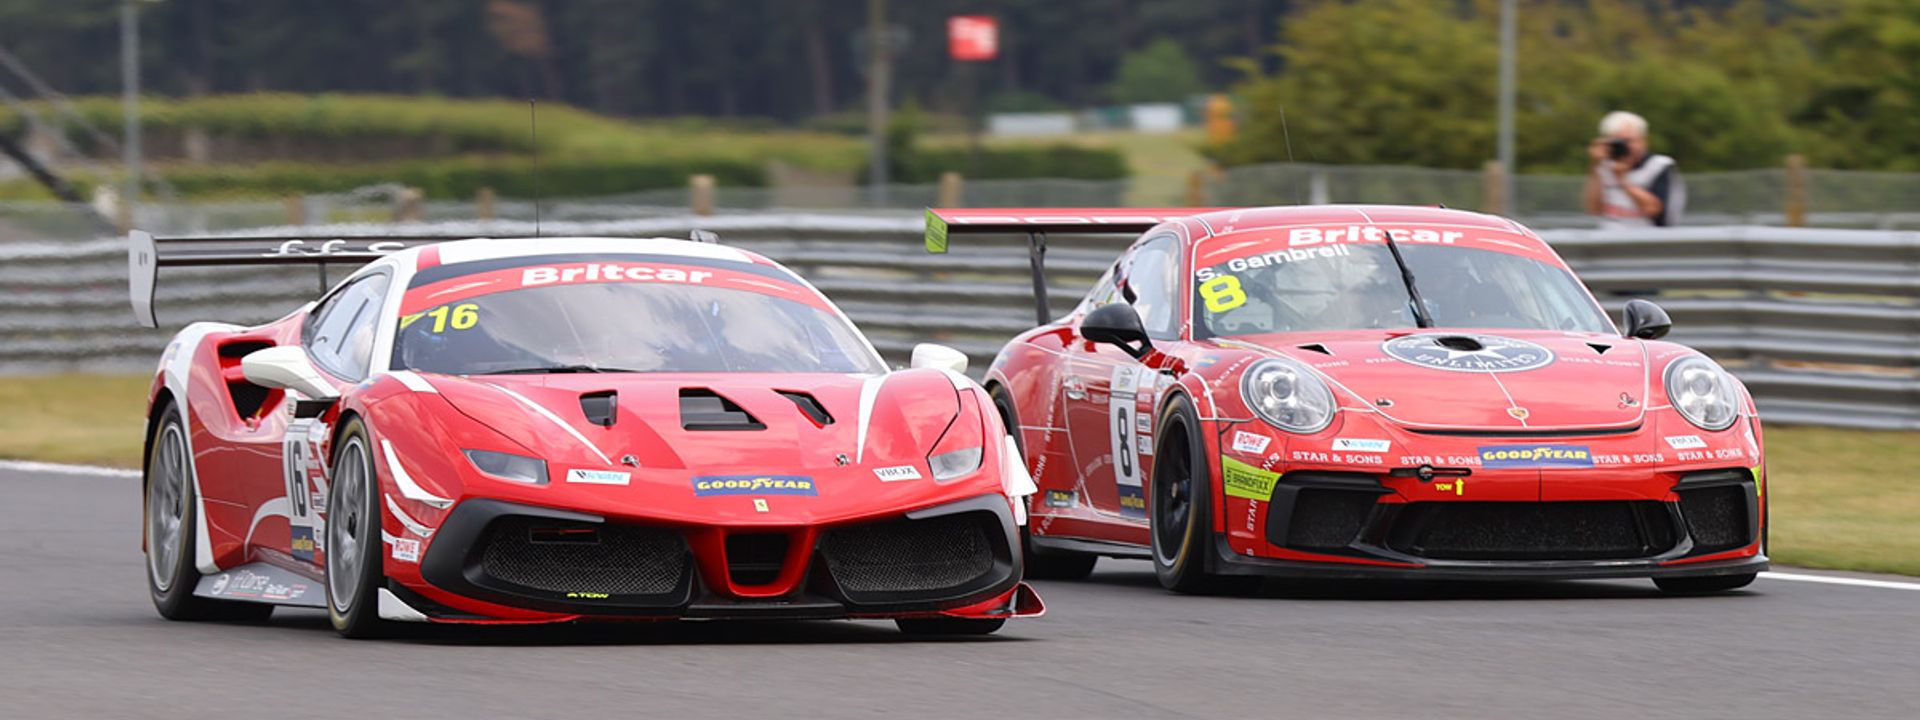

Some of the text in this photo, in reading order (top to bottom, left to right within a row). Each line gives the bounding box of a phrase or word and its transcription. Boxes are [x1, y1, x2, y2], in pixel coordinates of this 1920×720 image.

[1288, 226, 1463, 246] Britcar
[1195, 244, 1350, 282] S. Gambrell
[520, 263, 712, 287] Britcar
[1198, 274, 1247, 313] 8
[426, 303, 479, 333] 16
[1118, 406, 1132, 478] 8
[1293, 451, 1383, 465] STAR & SONS
[1401, 456, 1482, 466] STAR & SONS
[1483, 447, 1588, 461] GOODYEAR
[1592, 453, 1665, 464] STAR & SONS
[1678, 451, 1705, 461] STAR
[287, 440, 307, 518] 16
[697, 477, 811, 492] GOODYEAR
[1435, 483, 1453, 491] TOW
